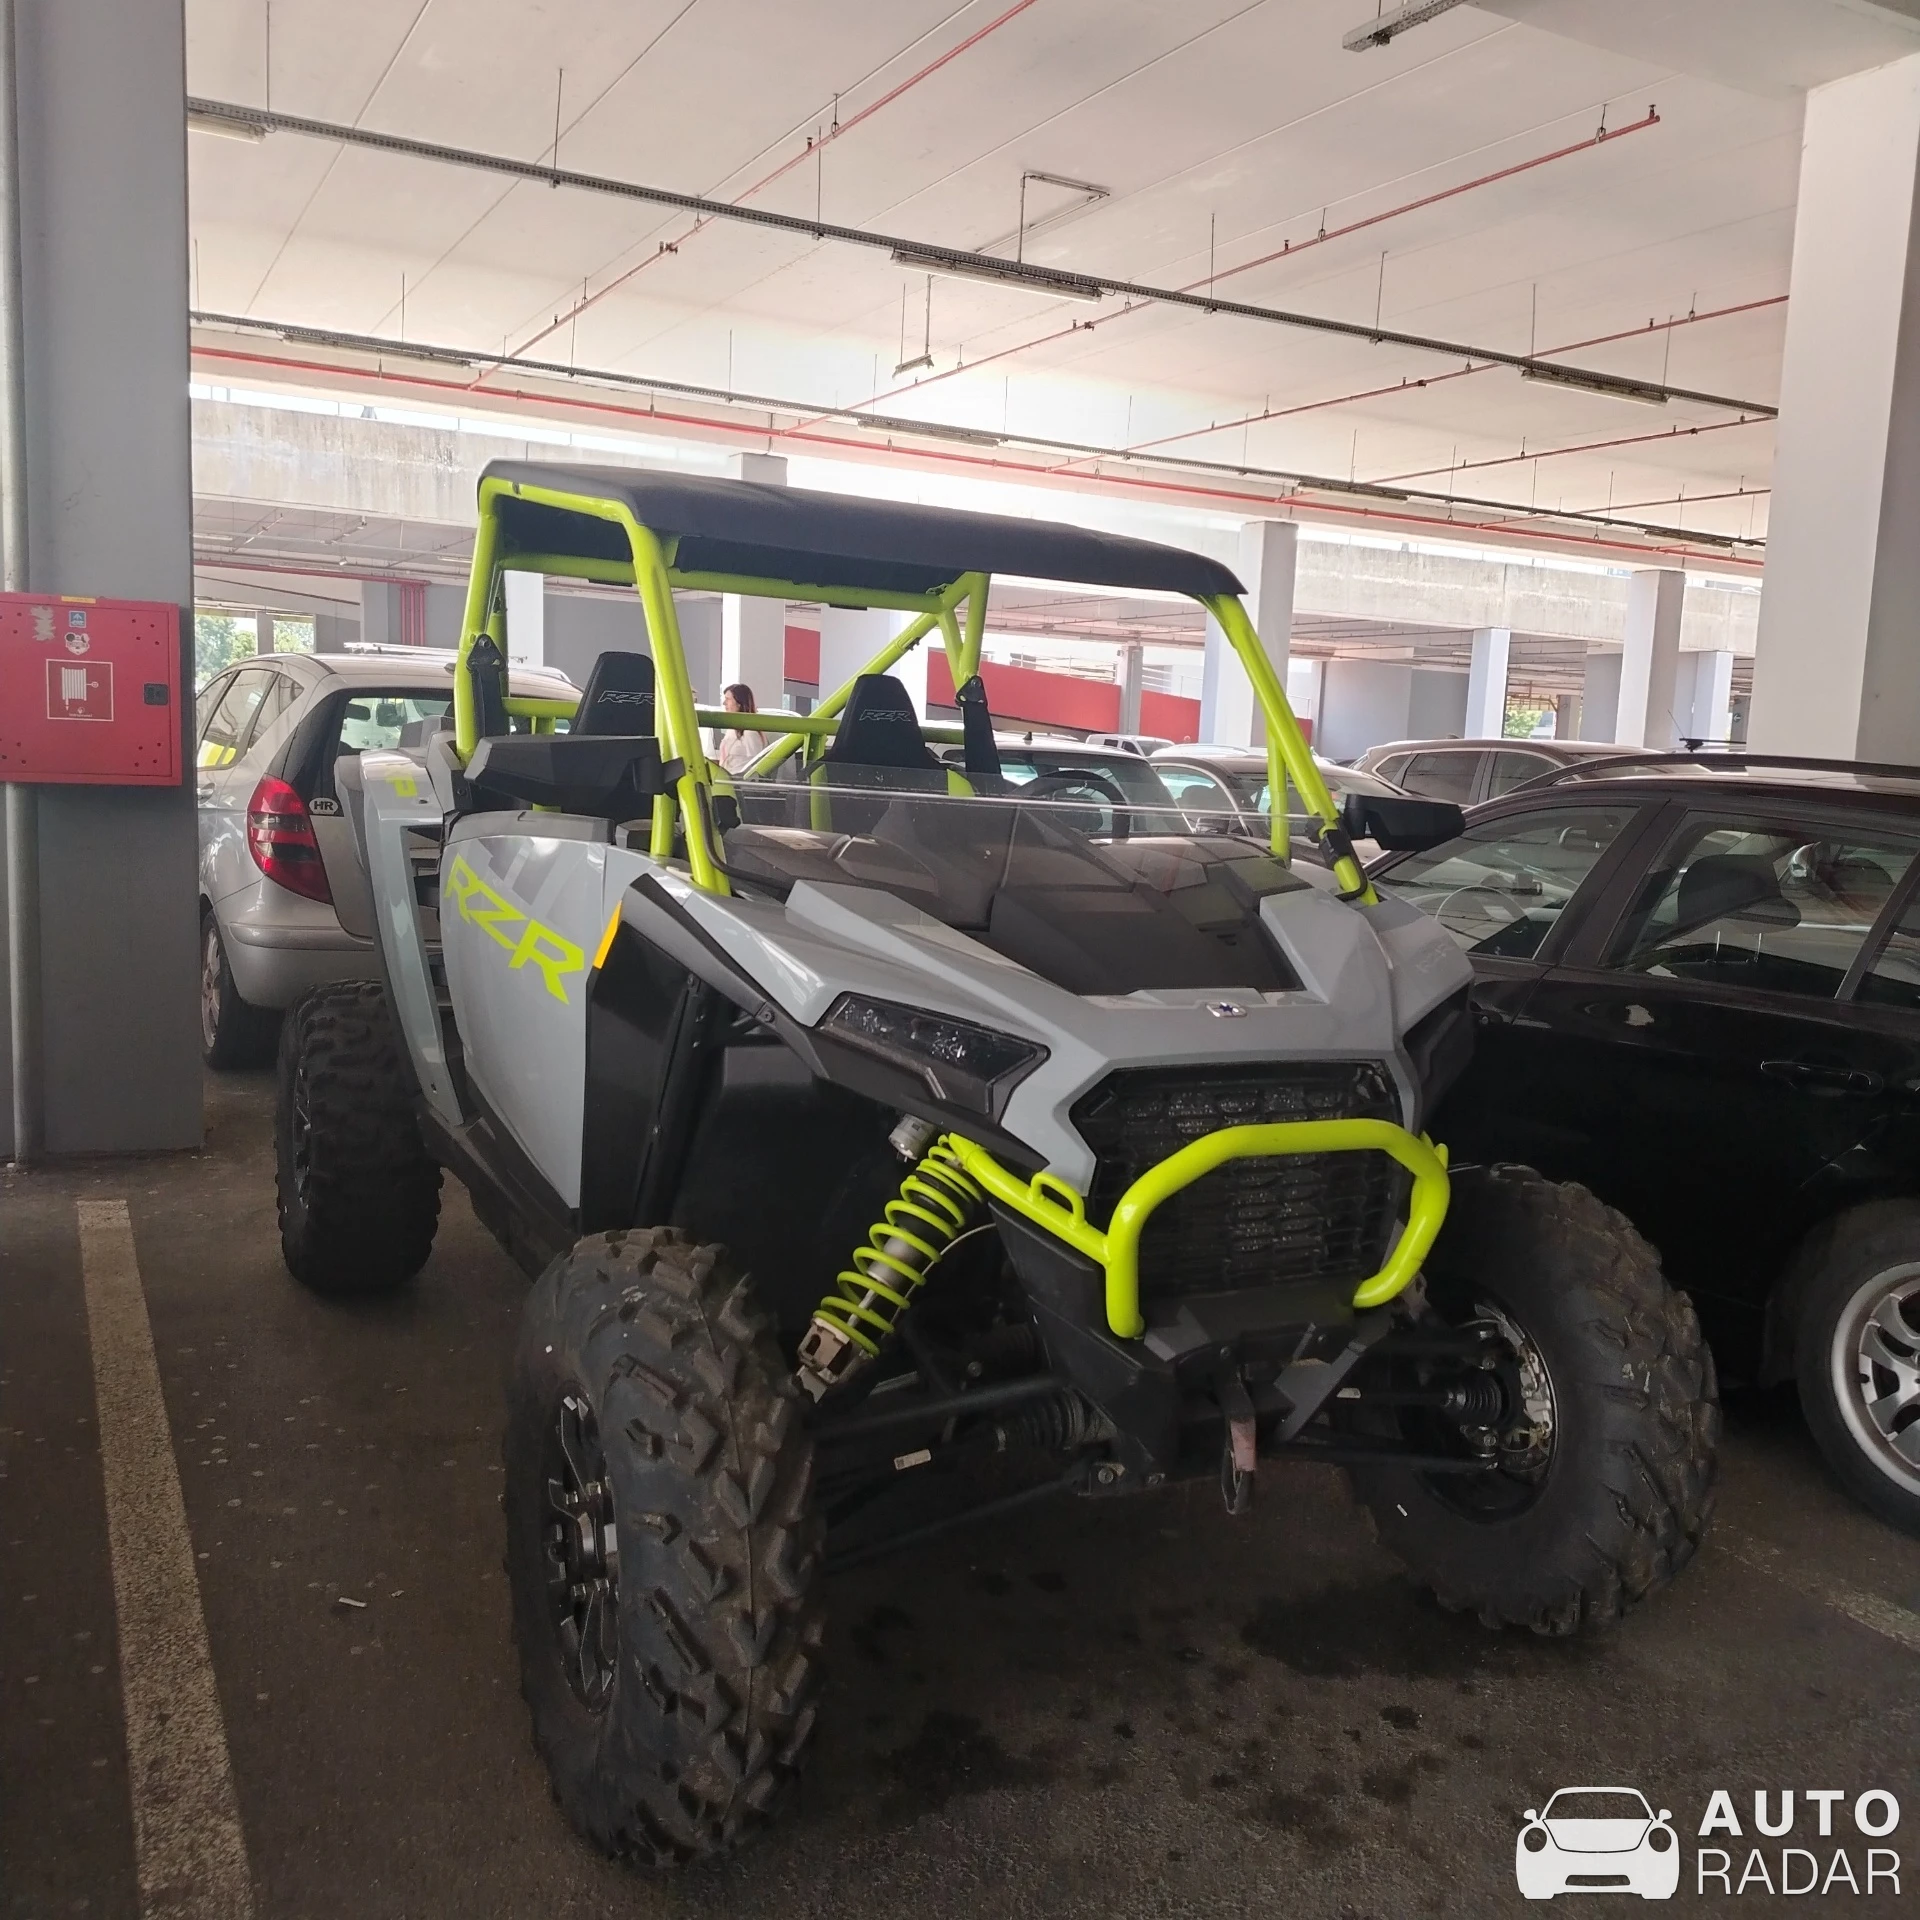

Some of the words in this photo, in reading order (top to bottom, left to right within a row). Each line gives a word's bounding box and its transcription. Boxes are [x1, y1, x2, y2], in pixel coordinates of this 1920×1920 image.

[859, 709, 911, 722] RZR
[314, 800, 334, 811] HR
[444, 852, 585, 1005] RZR
